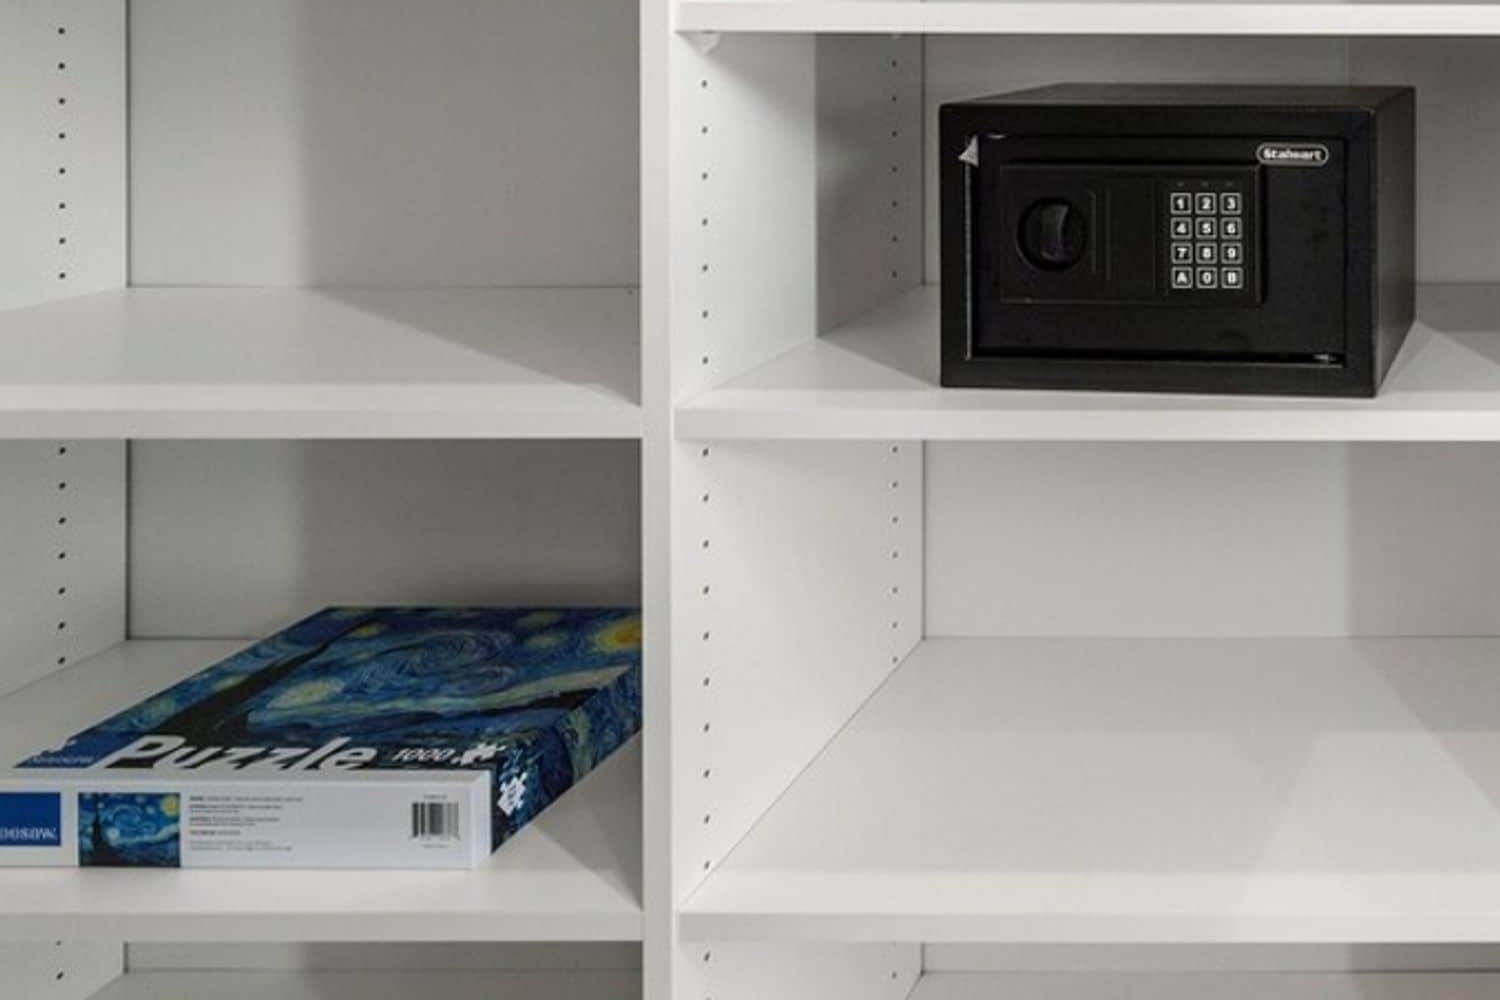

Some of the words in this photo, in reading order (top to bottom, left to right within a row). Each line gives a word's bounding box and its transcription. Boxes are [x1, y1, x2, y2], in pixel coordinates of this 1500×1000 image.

[1176, 198, 1185, 210] 1
[1202, 198, 1212, 210] 2
[1227, 198, 1238, 210] 3
[1176, 223, 1188, 234] 4
[1202, 223, 1212, 234] 5
[1227, 223, 1238, 234] 6
[1176, 247, 1188, 259] 7
[1202, 247, 1212, 259] 8
[1227, 247, 1238, 259] 9
[1176, 271, 1188, 284] A
[1202, 271, 1212, 284] 0
[1227, 271, 1238, 284] B
[91, 734, 377, 769] Puzzle
[391, 748, 455, 762] 1000
